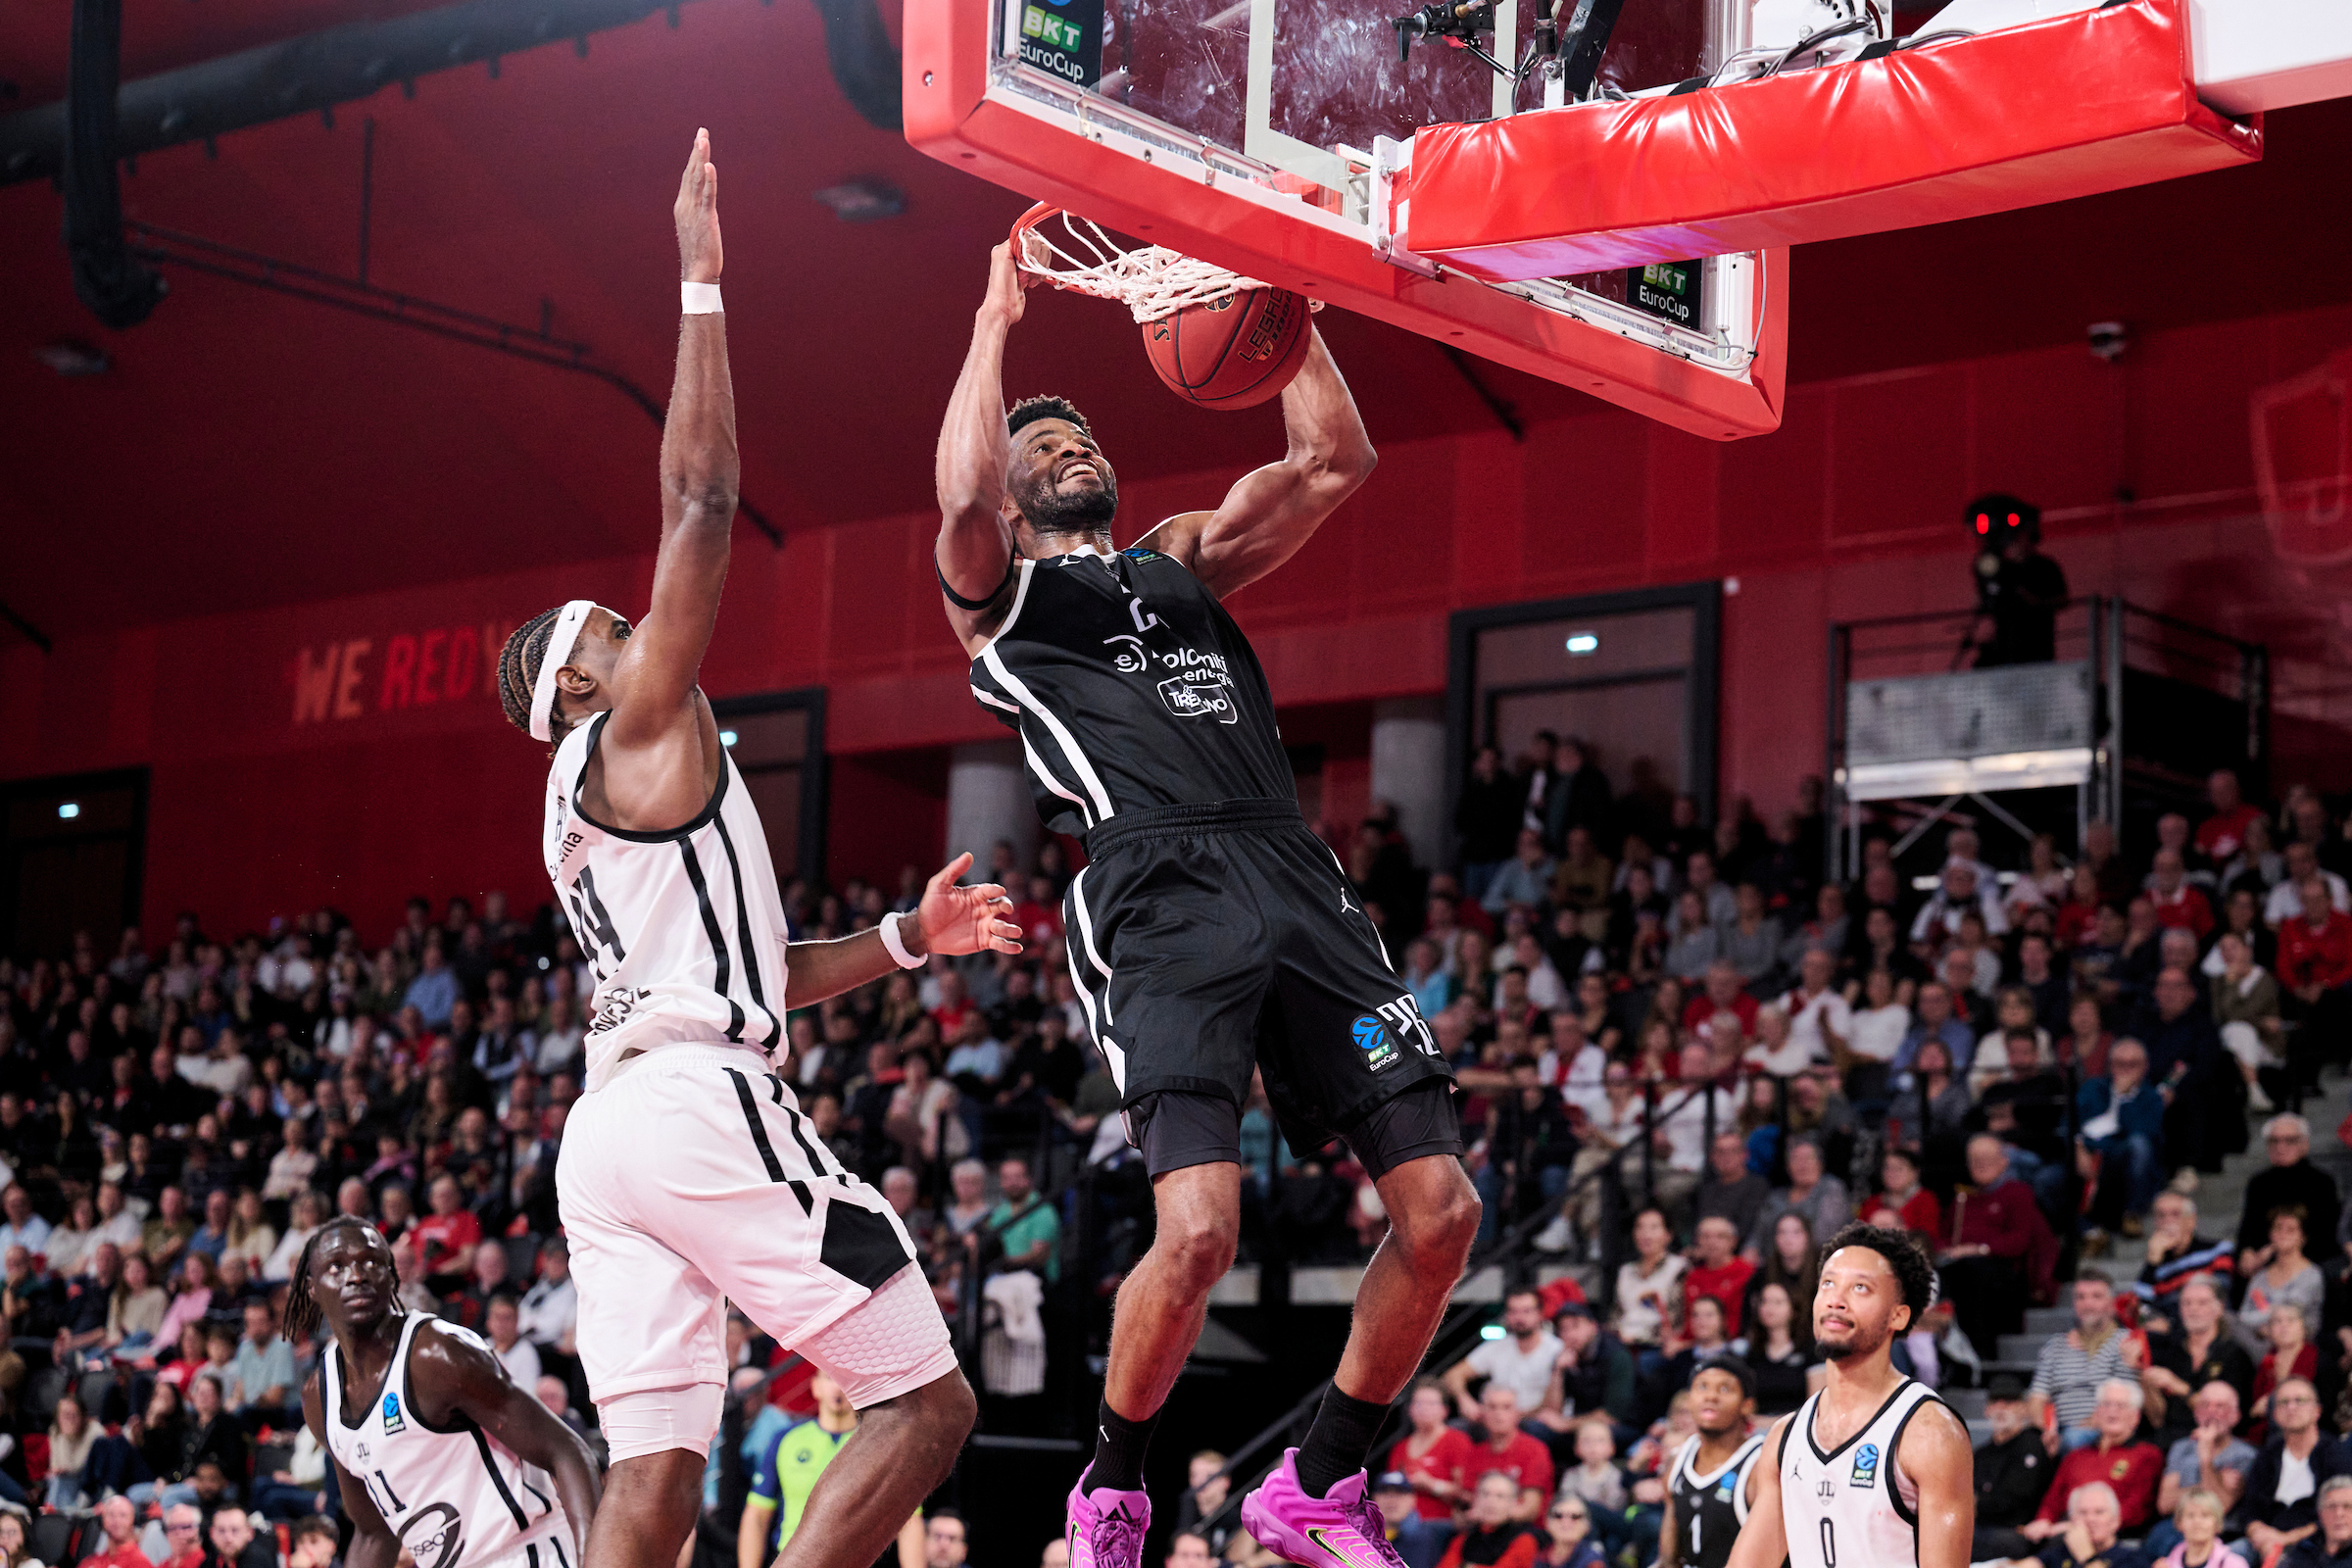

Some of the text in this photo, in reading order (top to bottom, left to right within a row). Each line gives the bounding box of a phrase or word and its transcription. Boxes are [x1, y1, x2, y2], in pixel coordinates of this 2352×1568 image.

[1025, 9, 1080, 47] BKT
[1019, 37, 1085, 82] EuroCup
[1644, 265, 1686, 290] BKT
[1640, 285, 1690, 320] EuroCup
[293, 640, 372, 724] WE
[379, 625, 478, 711] RED
[1368, 1043, 1391, 1061] BKT
[1369, 1052, 1399, 1071] EuroCup
[1689, 1513, 1702, 1555] 1
[1820, 1517, 1837, 1568] 0
